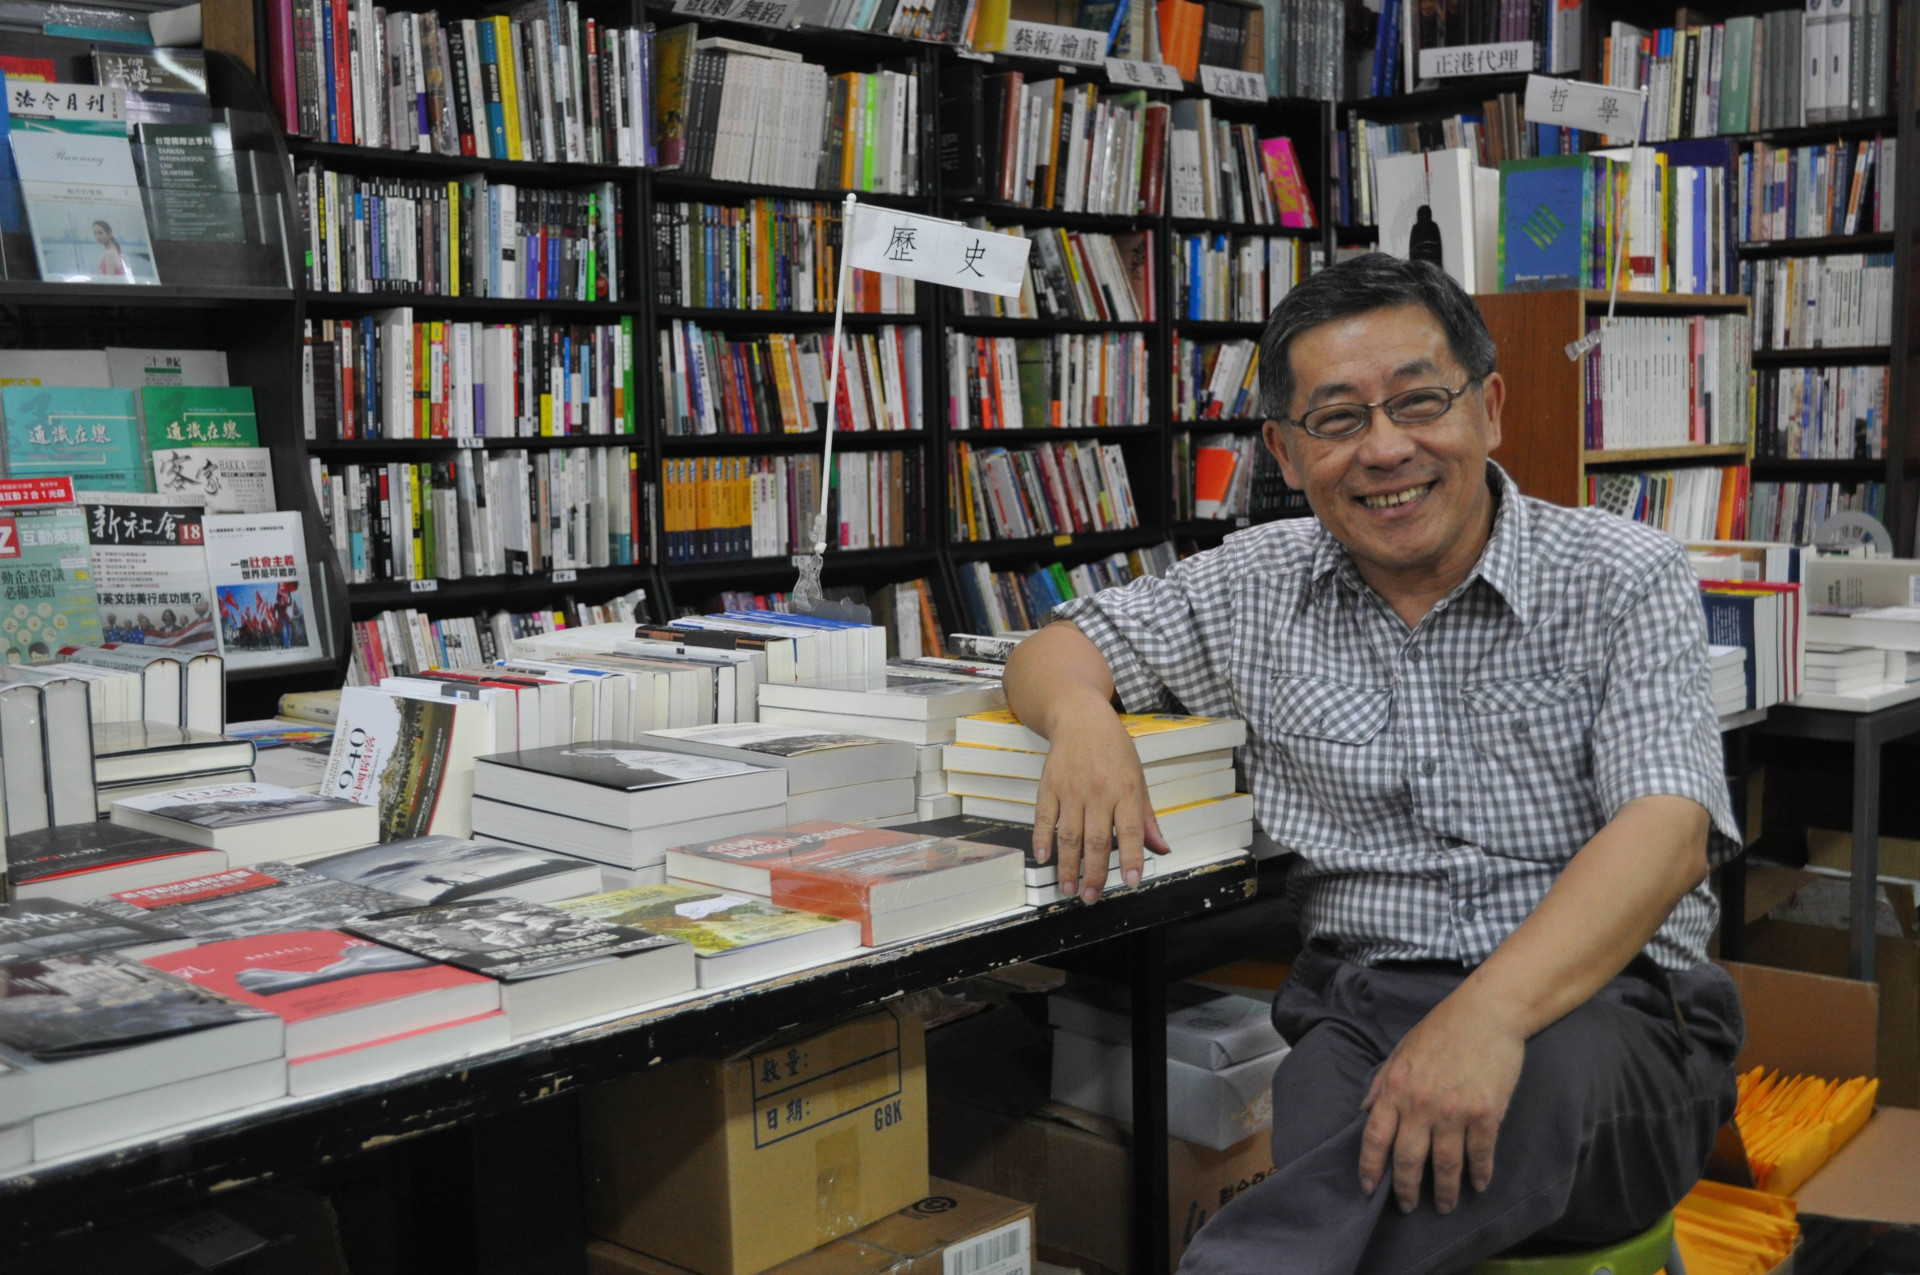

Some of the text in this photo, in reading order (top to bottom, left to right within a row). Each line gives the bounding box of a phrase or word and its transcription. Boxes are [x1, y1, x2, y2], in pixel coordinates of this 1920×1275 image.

[1434, 48, 1519, 76] 正港代理
[15, 89, 105, 114] 法令月刊
[1549, 86, 1619, 123] 哲學
[882, 225, 987, 278] 歷史
[29, 423, 112, 446] 通識在線
[166, 419, 243, 442] 通識在線
[218, 459, 246, 471] HAKKA
[91, 505, 186, 545] 新社會
[181, 523, 201, 541] 18
[230, 554, 296, 570] 一個社會主義
[242, 567, 297, 580] 世界是可能的
[766, 1098, 811, 1130] 日期:
[874, 1099, 903, 1132] G8K
